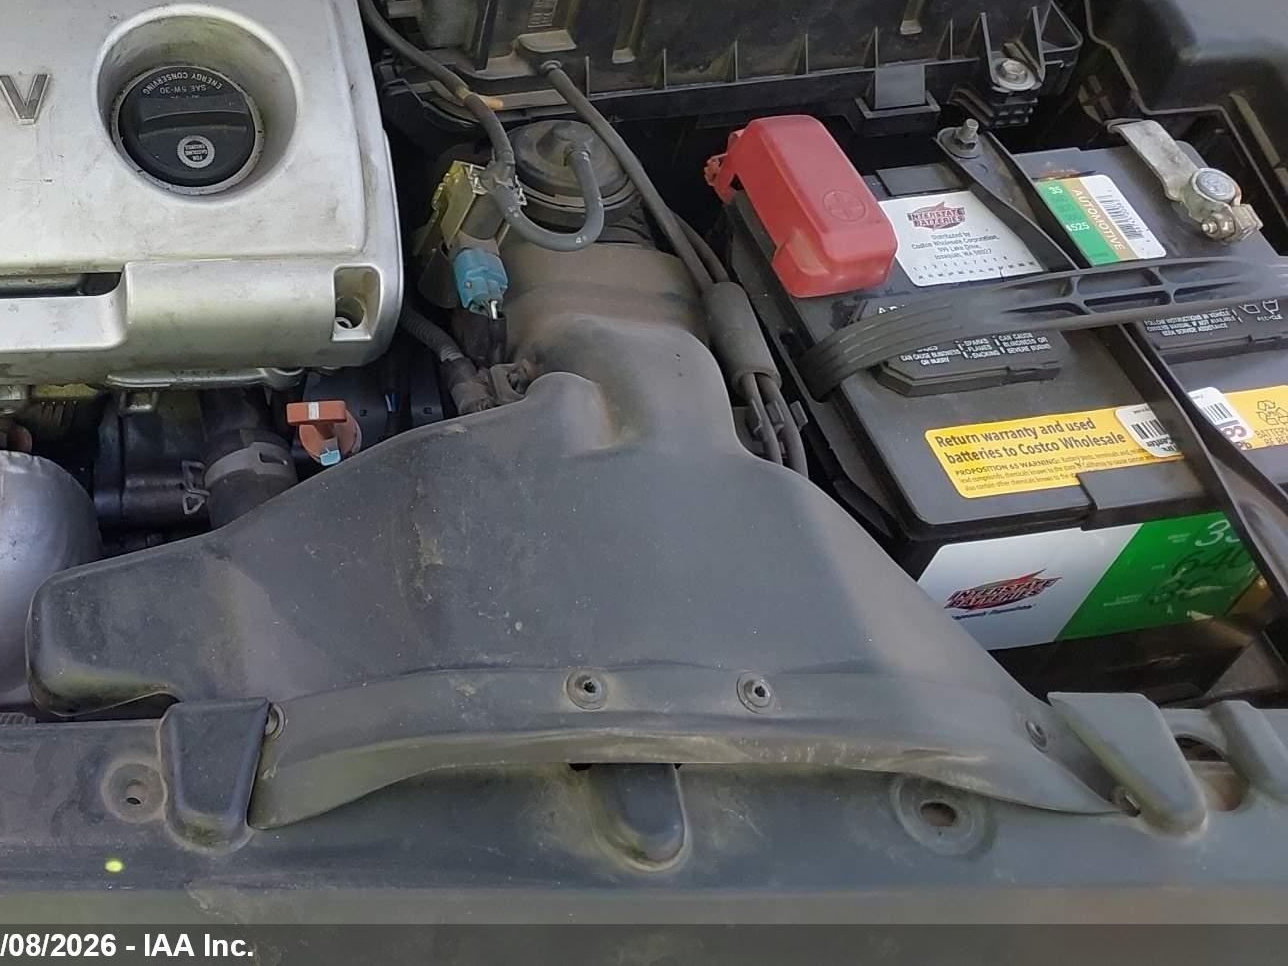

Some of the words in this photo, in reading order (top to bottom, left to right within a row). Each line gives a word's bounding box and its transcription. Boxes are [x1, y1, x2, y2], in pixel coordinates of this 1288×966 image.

[142, 71, 189, 95] CONSERVING
[190, 83, 206, 93] SAE
[191, 71, 223, 91] ENERGY
[1048, 185, 1063, 195] 35
[907, 207, 965, 221] INTERSTATE
[1072, 189, 1125, 251] AUTOMOTIVE
[913, 216, 965, 228] BATTERIES
[935, 431, 981, 450] Return
[982, 426, 1038, 443] warranty
[1039, 422, 1064, 436] and
[1064, 417, 1097, 432] used
[1255, 427, 1288, 439] BATTER
[944, 446, 1003, 465] batteries
[1003, 444, 1017, 458] to
[1017, 438, 1060, 456] Costco
[1060, 431, 1126, 450] Wholesale
[955, 464, 1009, 476] PROPOSITION
